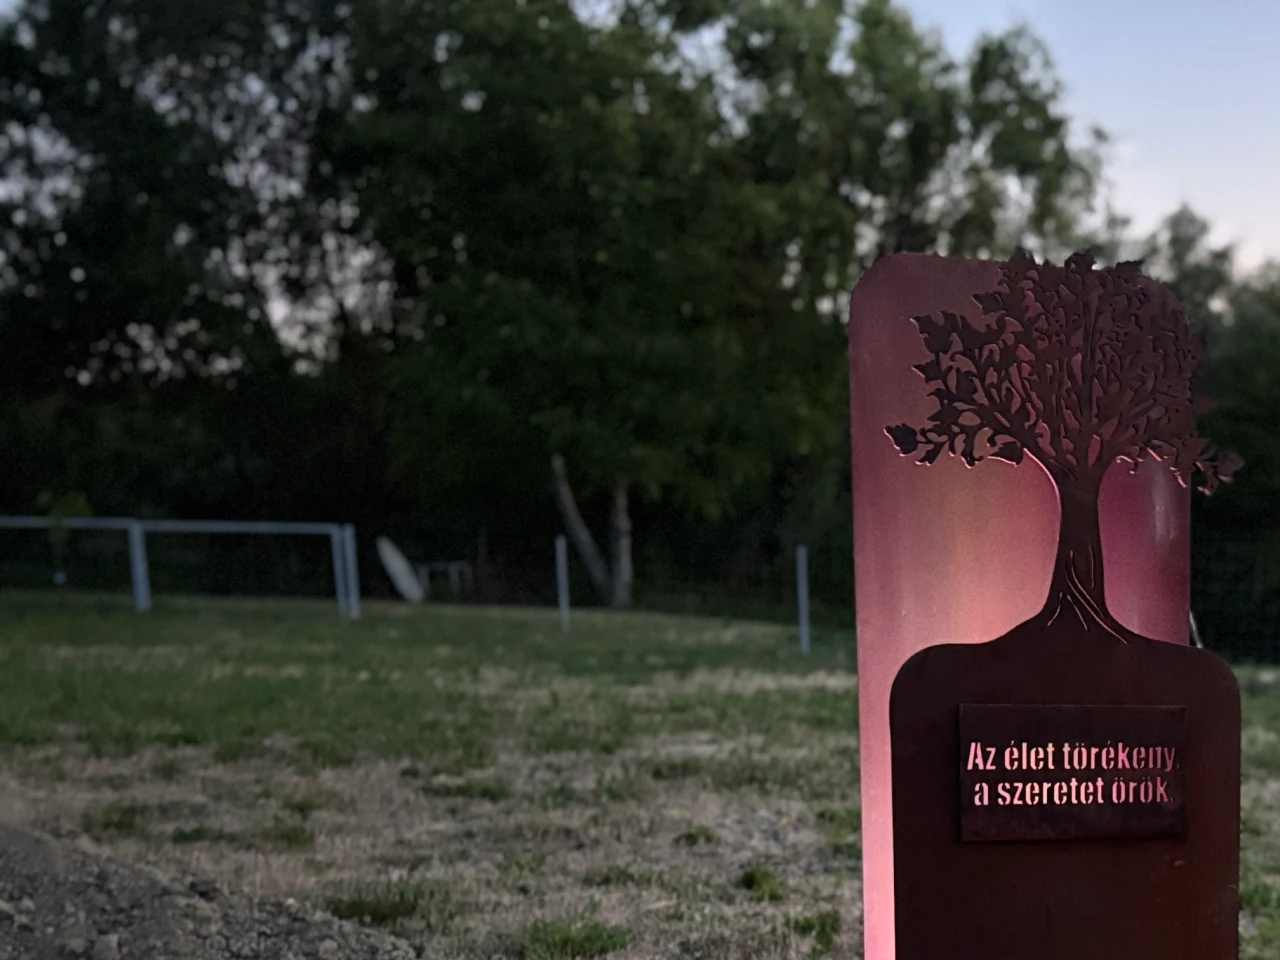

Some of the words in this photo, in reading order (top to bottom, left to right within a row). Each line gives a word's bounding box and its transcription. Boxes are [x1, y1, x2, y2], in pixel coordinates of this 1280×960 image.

[967, 742, 997, 771] Az
[1004, 740, 1056, 770] élet
[973, 782, 989, 806] a
[997, 777, 1104, 806] szeretet
